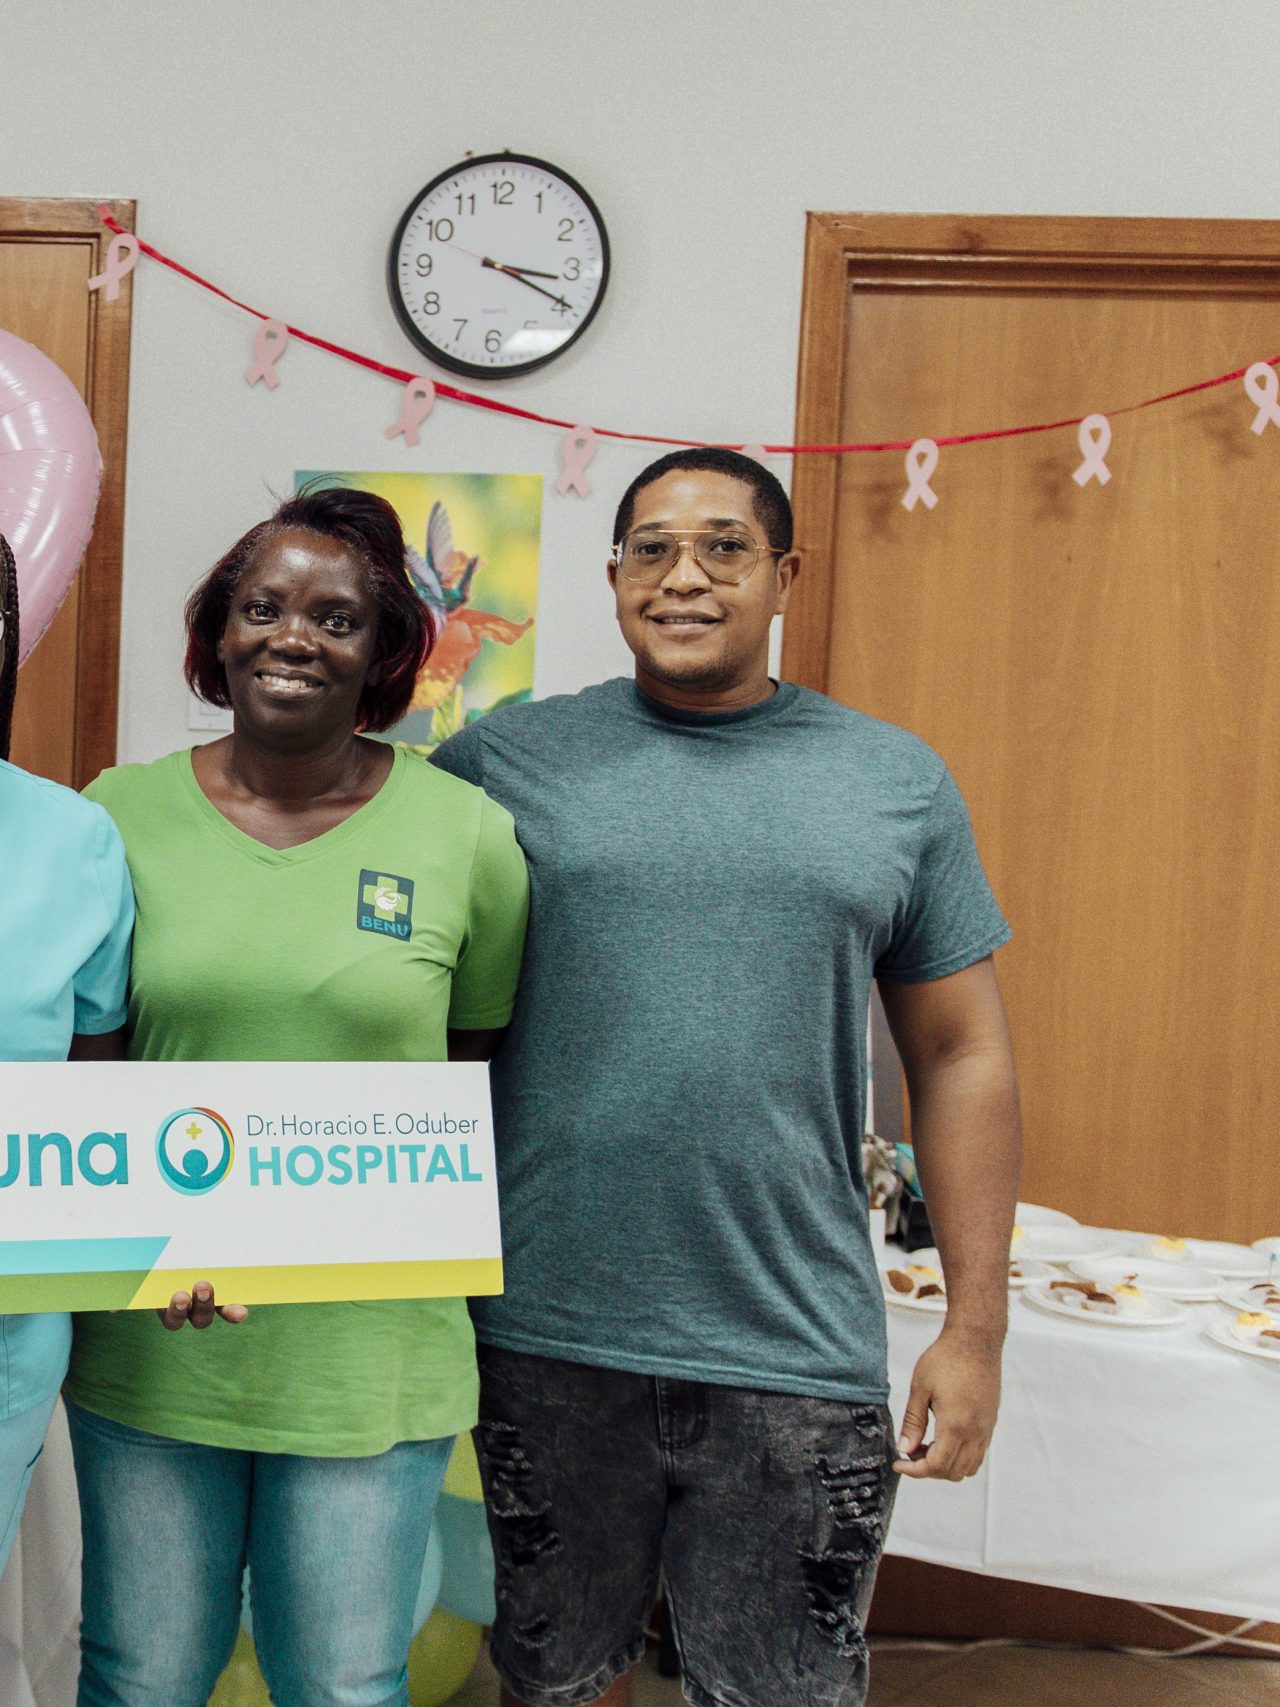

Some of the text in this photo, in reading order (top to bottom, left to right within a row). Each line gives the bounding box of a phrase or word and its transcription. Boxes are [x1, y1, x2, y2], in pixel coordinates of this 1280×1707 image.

[455, 193, 475, 215] 11
[489, 181, 515, 205] 12
[534, 192, 543, 213] 1
[426, 218, 454, 242] 10
[557, 218, 574, 242] 2
[416, 253, 432, 277] 9
[563, 257, 580, 281] 3
[423, 292, 440, 315] 8
[551, 295, 567, 317] 4
[453, 318, 468, 341] 7
[485, 329, 502, 352] 6
[361, 915, 408, 937] BENU
[247, 1112, 479, 1136] Dr. Horacio E. Oduber
[248, 1143, 483, 1186] HOSPITAL
